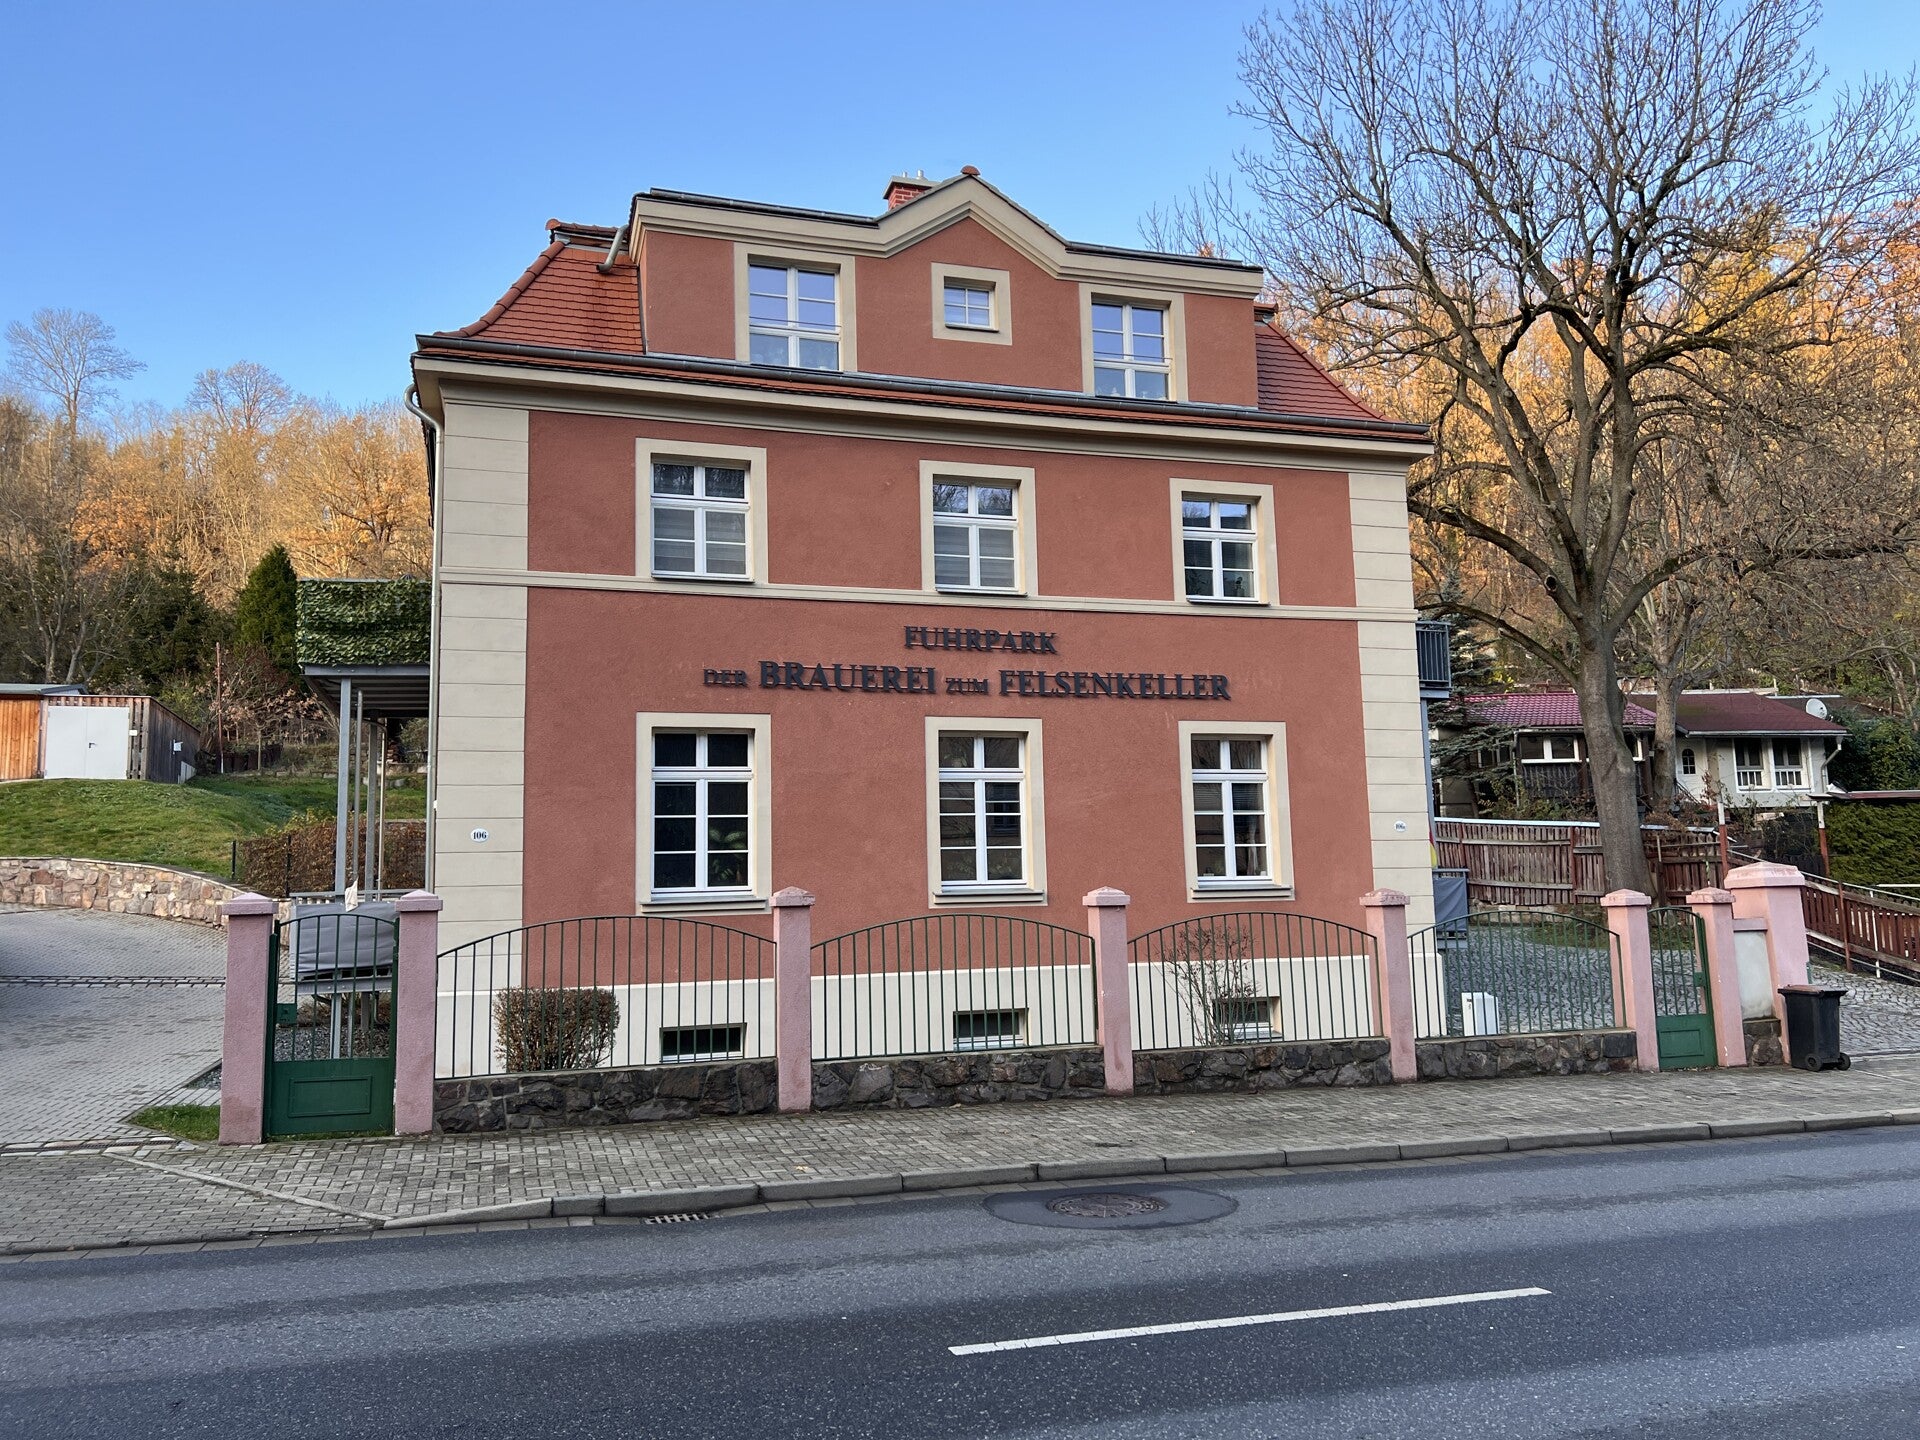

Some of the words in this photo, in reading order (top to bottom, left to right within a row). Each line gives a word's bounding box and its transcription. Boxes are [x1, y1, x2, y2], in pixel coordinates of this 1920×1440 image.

[904, 626, 1057, 654] FUHRPARK
[703, 668, 748, 687] DER
[758, 660, 936, 693] BRAUEREI
[946, 677, 988, 694] ZUM
[999, 669, 1231, 700] FELSENKELLER
[473, 831, 487, 840] 106
